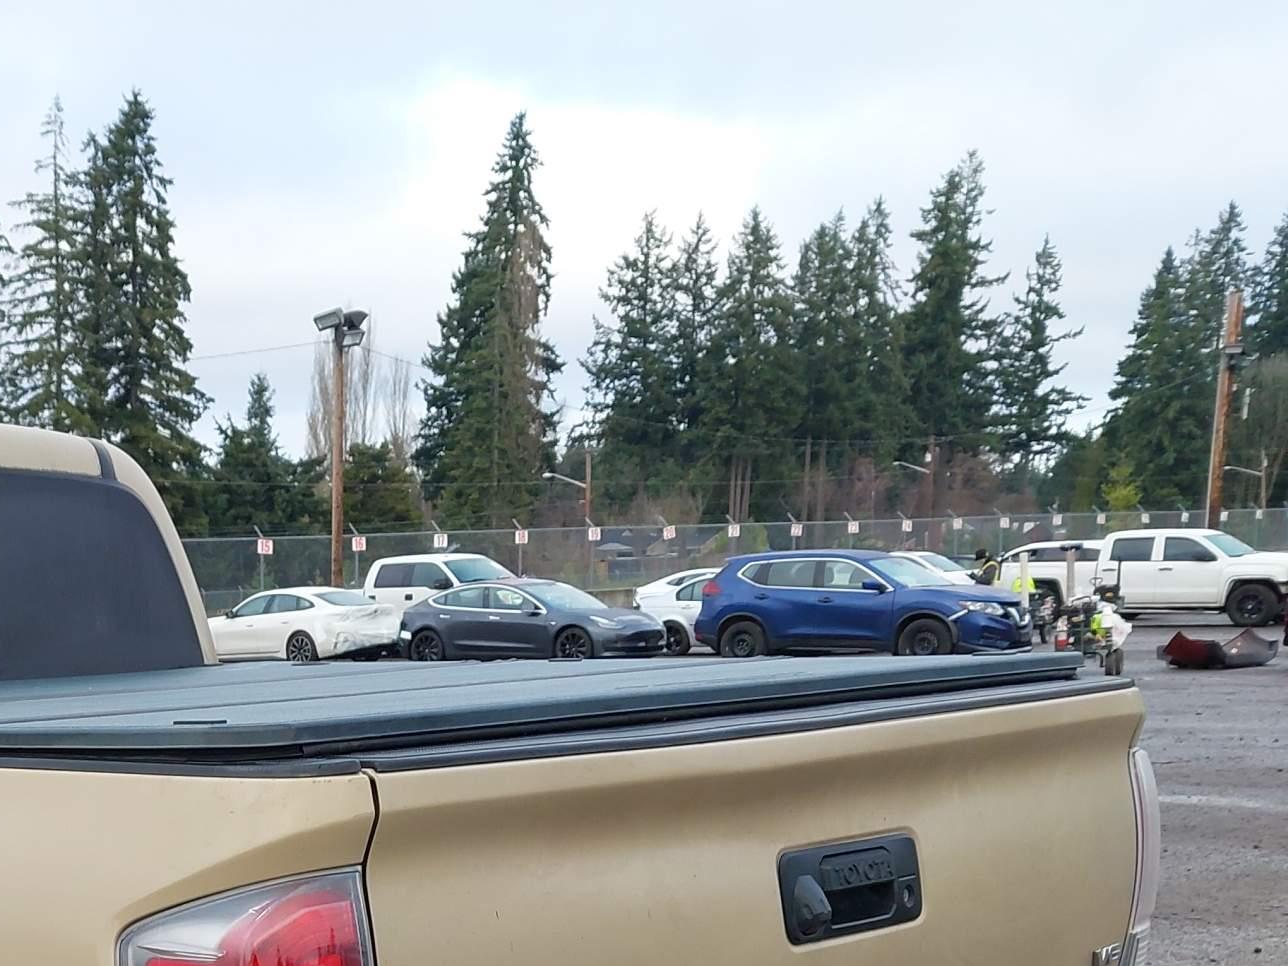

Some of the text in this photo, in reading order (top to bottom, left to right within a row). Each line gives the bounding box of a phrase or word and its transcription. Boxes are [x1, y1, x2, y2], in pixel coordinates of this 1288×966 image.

[665, 526, 675, 539] 20
[259, 539, 270, 553] 15
[353, 537, 363, 550] 16
[833, 859, 894, 887] TOYOTA
